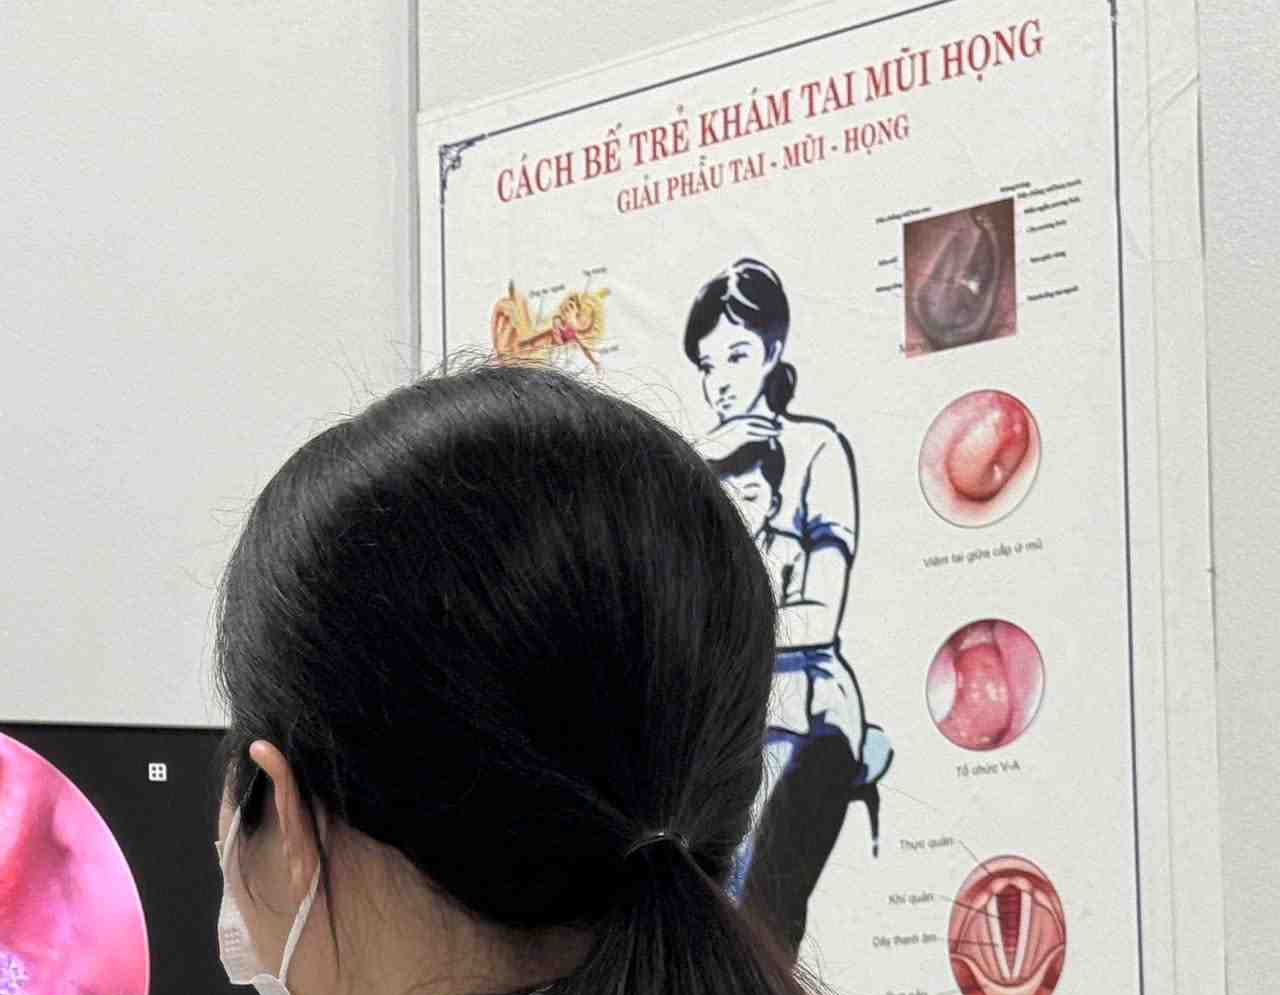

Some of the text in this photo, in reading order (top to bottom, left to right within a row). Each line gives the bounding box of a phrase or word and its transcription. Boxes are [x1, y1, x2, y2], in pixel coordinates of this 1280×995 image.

[496, 18, 1045, 203] CÁCH BẾ TRẺ KHÁM TAI MŨI HỌNG
[616, 173, 661, 214] GIẢI
[667, 154, 726, 202] PHẪU
[729, 152, 767, 186] TAI
[783, 133, 826, 171] MŨI
[843, 113, 911, 156] HỌNG
